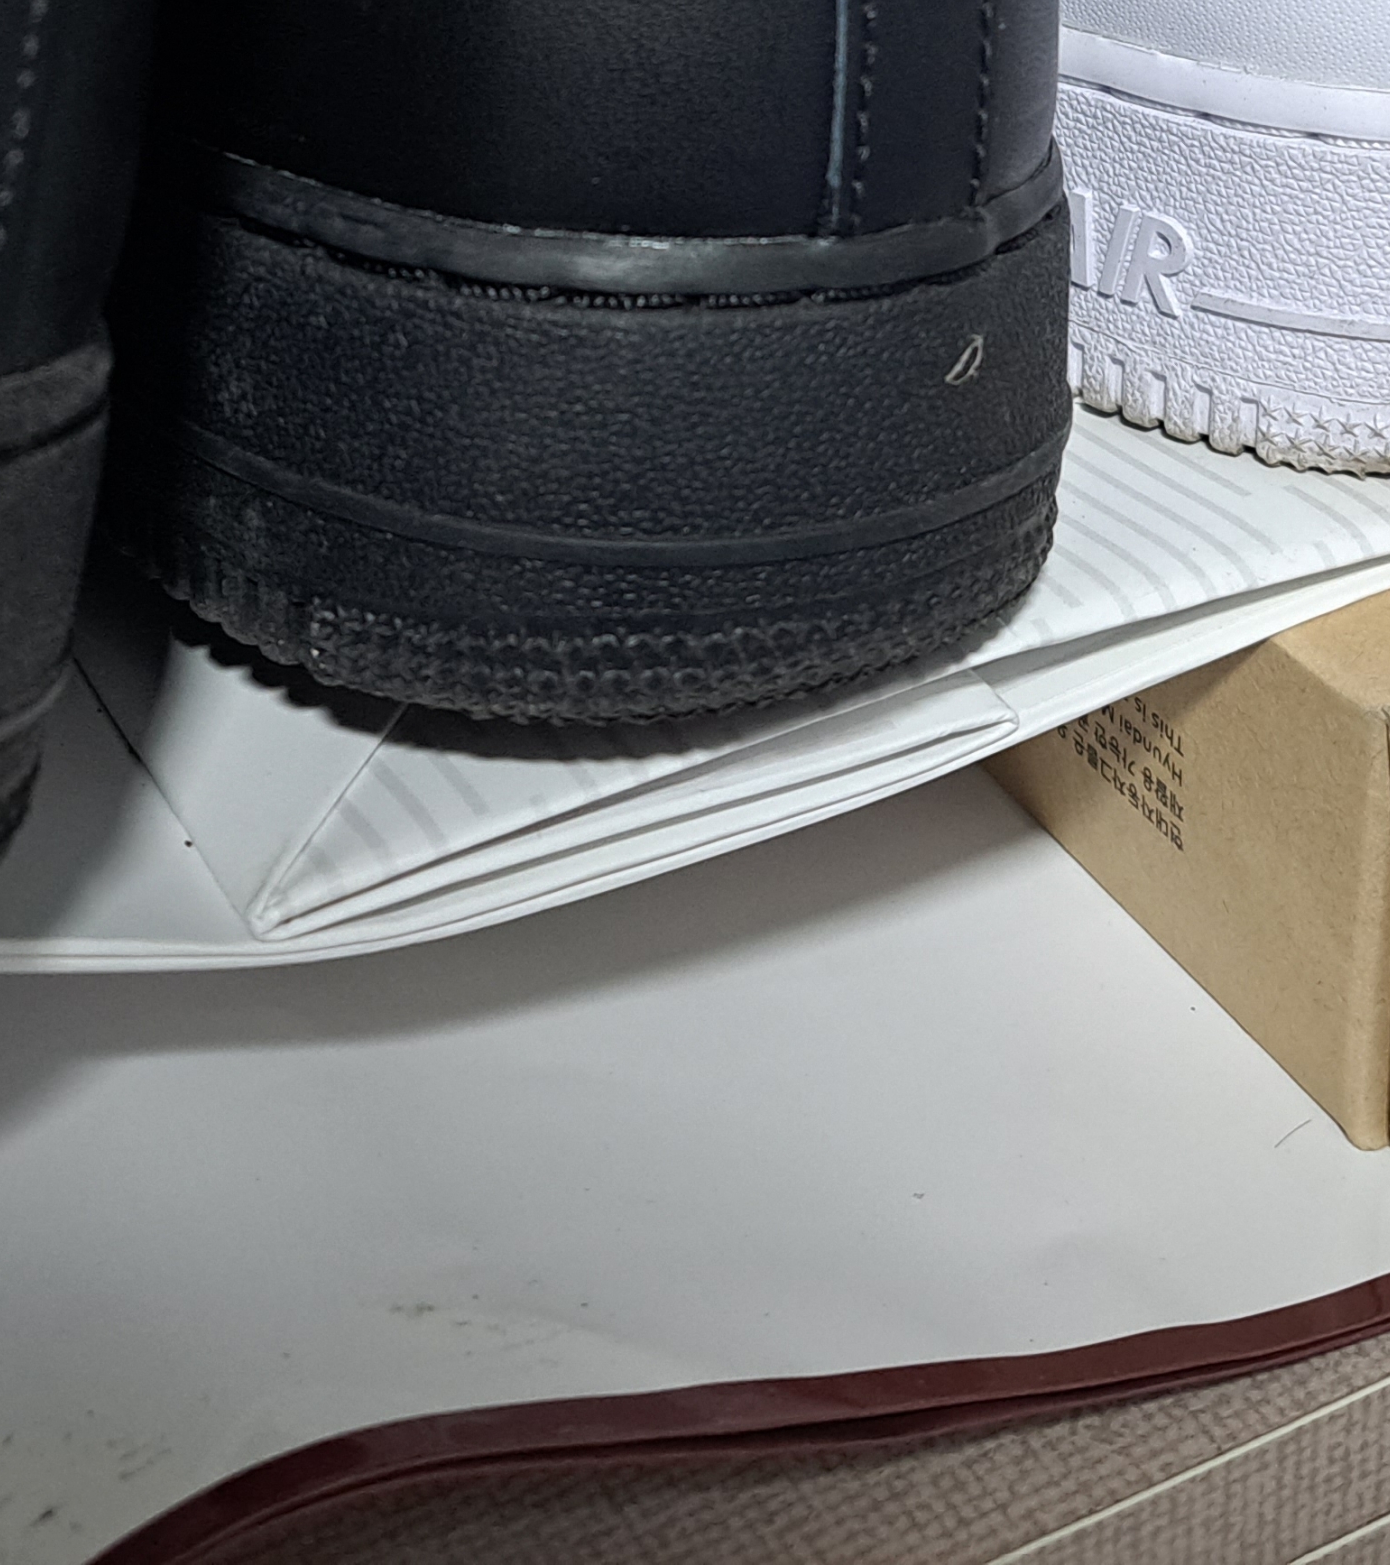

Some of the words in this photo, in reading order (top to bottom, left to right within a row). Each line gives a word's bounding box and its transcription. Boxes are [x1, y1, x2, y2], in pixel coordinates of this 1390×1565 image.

[1134, 696, 1147, 723] is
[1151, 712, 1185, 758] This
[1094, 721, 1136, 777] 가능한
[1119, 715, 1183, 787] Hyundai
[1140, 766, 1184, 823] 재활용
